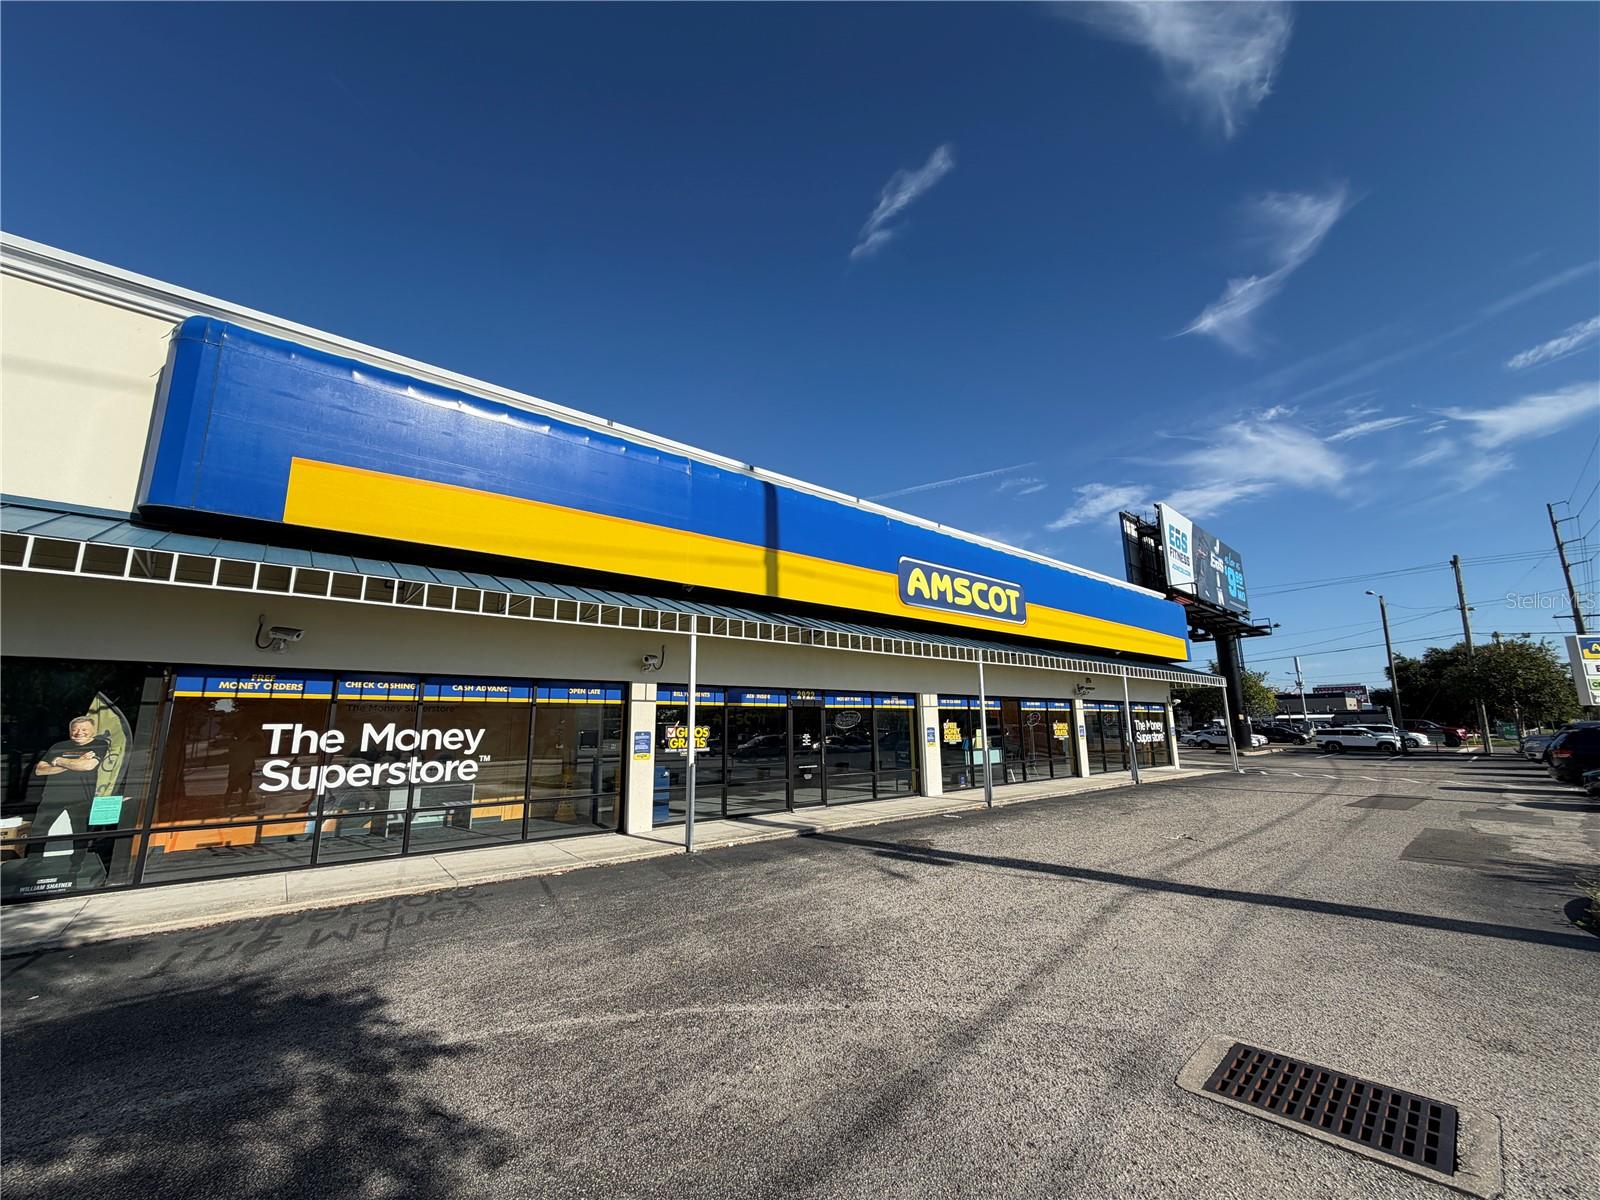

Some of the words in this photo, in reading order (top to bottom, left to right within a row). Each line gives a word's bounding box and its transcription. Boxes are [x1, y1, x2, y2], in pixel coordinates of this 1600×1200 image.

[1170, 546, 1190, 567] FITNESS
[907, 567, 1020, 616] AMSCOT
[251, 674, 276, 682] FREE
[218, 681, 260, 690] MONEY
[262, 683, 304, 691] ORDERS
[345, 681, 375, 689] CHECK
[377, 682, 416, 690] CASHING
[1134, 719, 1146, 731] The
[1146, 720, 1164, 732] Money
[676, 727, 709, 738] GIOS
[262, 723, 345, 755] The
[360, 723, 486, 755] Money
